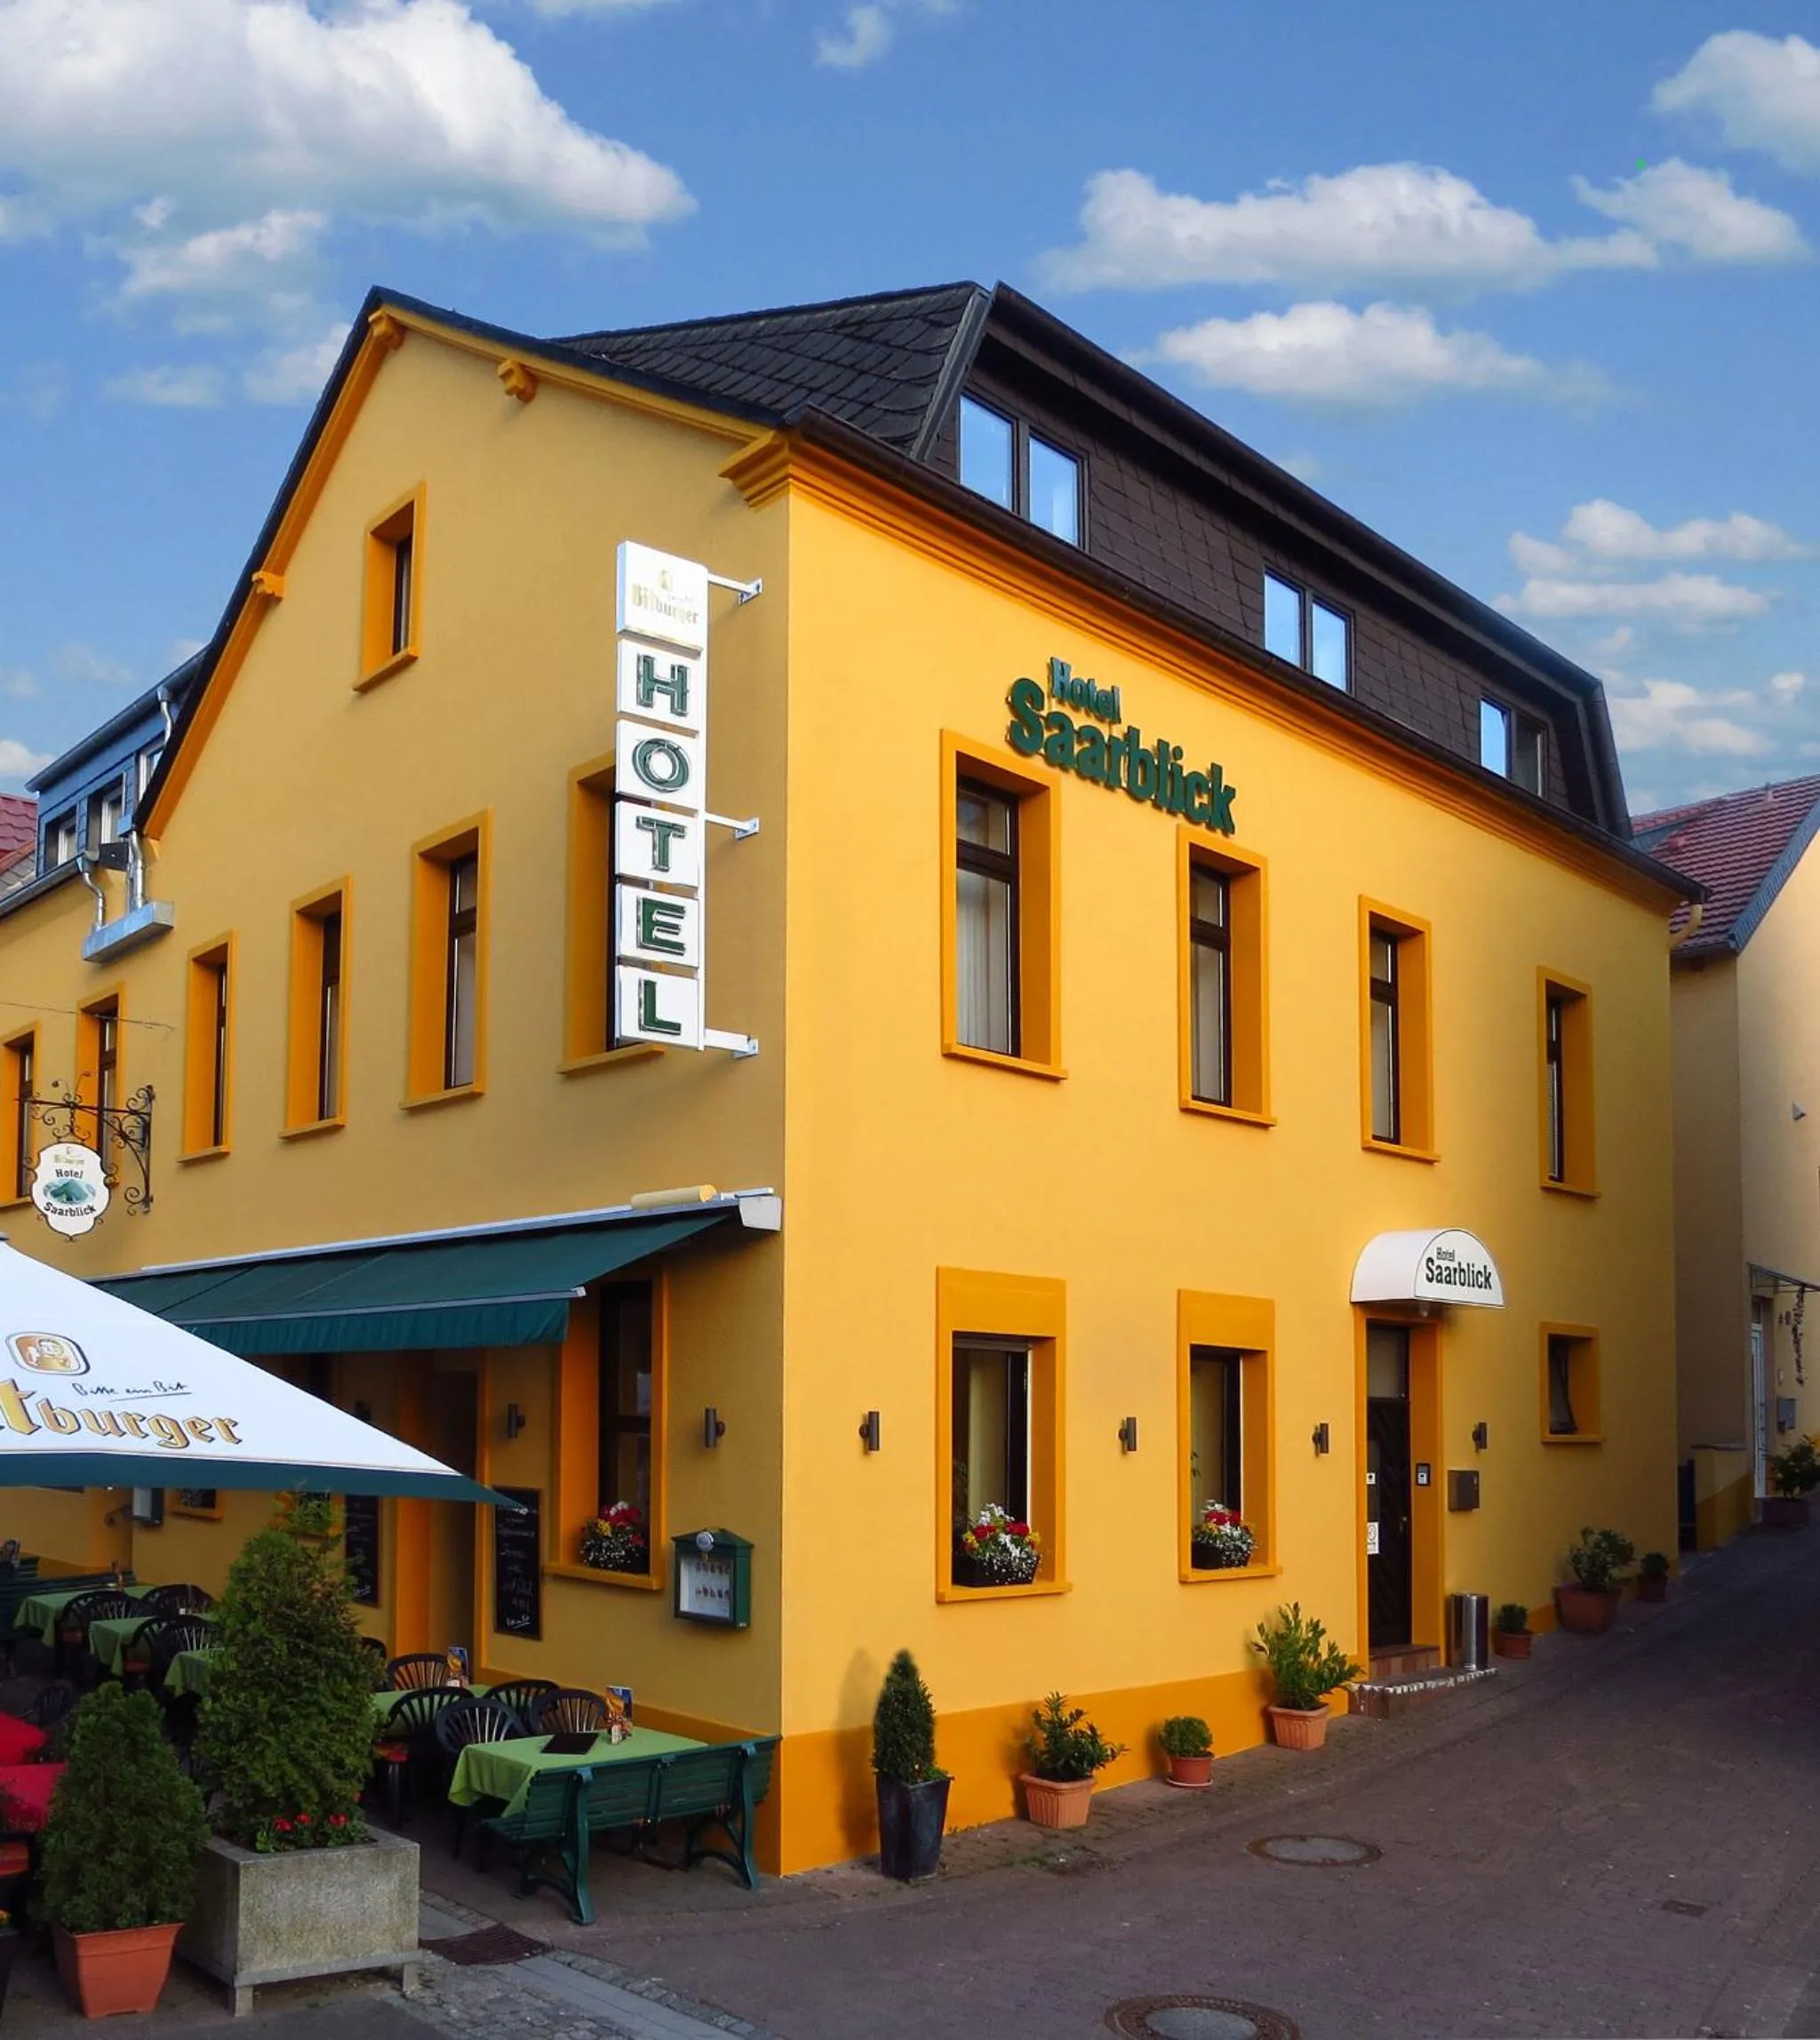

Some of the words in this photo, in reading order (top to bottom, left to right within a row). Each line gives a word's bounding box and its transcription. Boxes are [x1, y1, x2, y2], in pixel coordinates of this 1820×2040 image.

[1049, 657, 1122, 724] Hotel
[1007, 678, 1236, 836] Saarblick
[631, 652, 690, 1036] HOTEL
[55, 1168, 84, 1179] Hotel
[44, 1201, 97, 1217] Saarblick
[1425, 1256, 1492, 1290] Saarblick
[1436, 1247, 1456, 1263] Hotel
[0, 1378, 242, 1450] tburger
